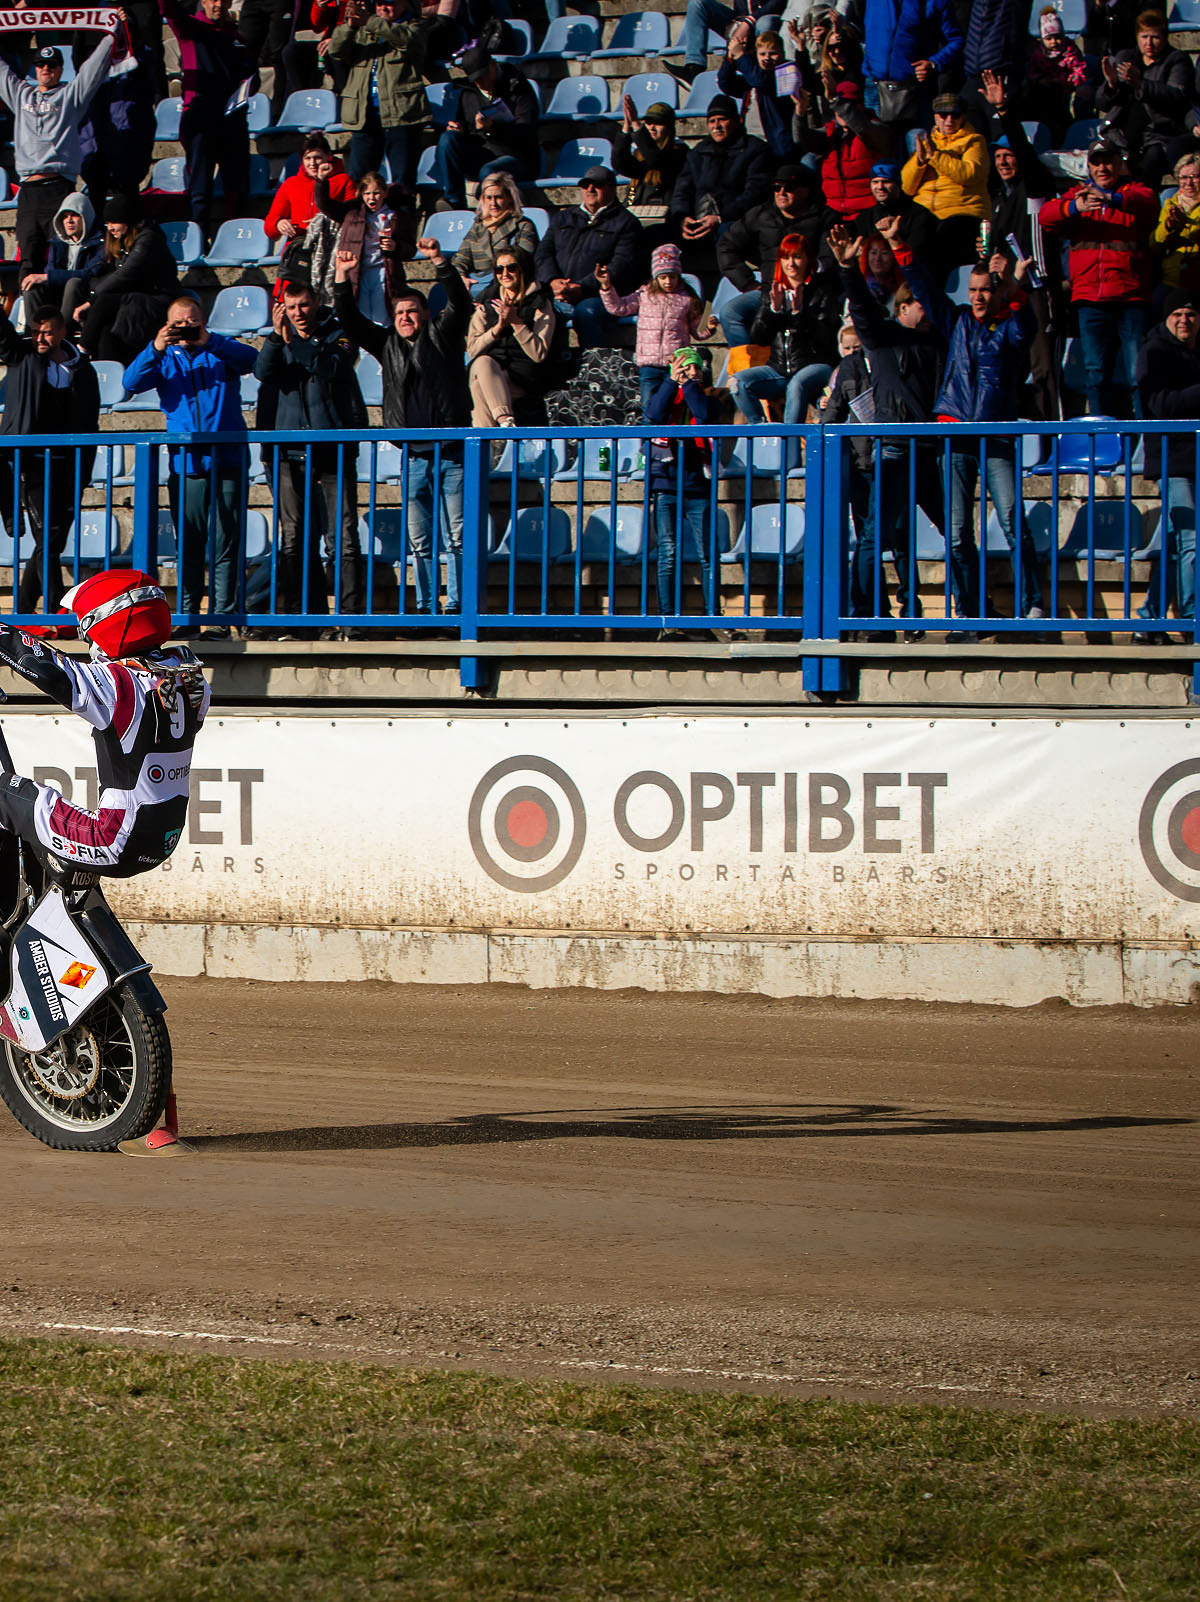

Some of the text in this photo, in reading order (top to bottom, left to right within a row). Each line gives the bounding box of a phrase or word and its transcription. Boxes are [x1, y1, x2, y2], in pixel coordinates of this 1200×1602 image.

[578, 145, 595, 156] 27
[447, 219, 464, 232] 26
[236, 295, 250, 308] 24
[82, 528, 98, 540] 25
[169, 690, 186, 739] 9
[613, 770, 948, 853] OPTIBET
[51, 836, 110, 860] SOFIA
[162, 852, 265, 874] BĀRS
[614, 861, 948, 884] SPORTA BĀRS
[28, 940, 64, 1022] AMBER STUDIOS
